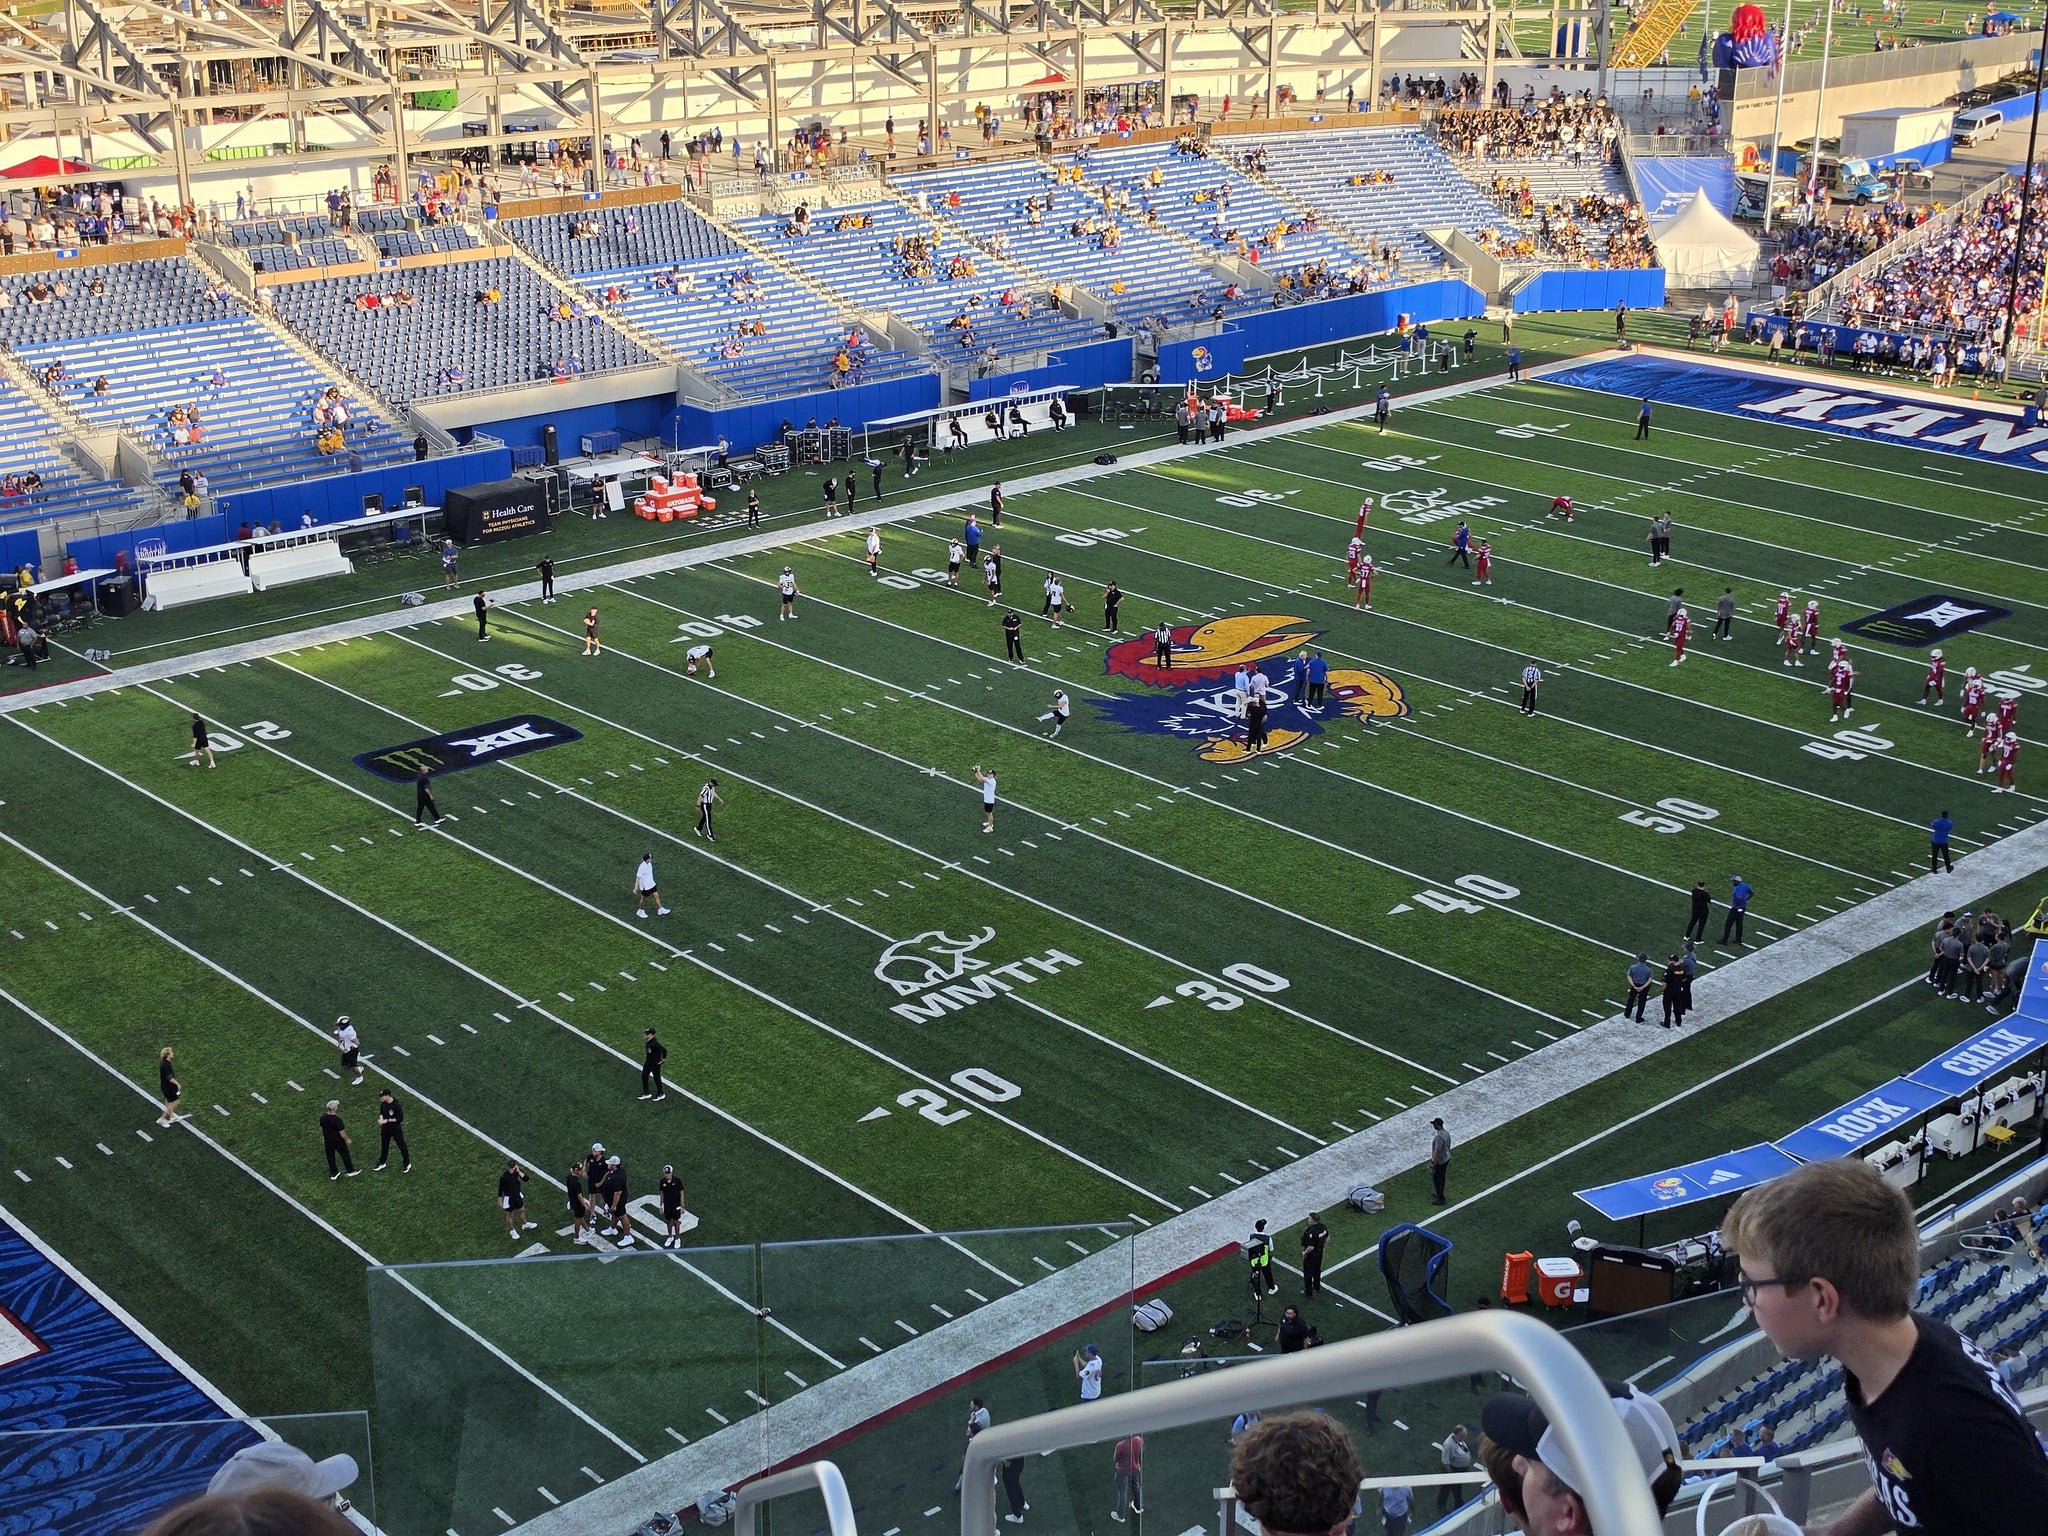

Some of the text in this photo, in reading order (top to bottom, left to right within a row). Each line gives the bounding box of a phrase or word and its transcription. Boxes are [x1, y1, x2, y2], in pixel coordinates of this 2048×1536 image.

[1361, 454, 1427, 471] 20
[492, 504, 535, 519] Health Care
[667, 496, 695, 507] GATORADE
[1215, 489, 1285, 508] 30
[1399, 495, 1509, 525] MMTH
[493, 524, 511, 533] MIZZOU
[511, 519, 536, 529] ATHLETICS
[501, 515, 529, 526] PHYSICIANS
[1054, 527, 1130, 547] 40
[877, 567, 948, 590] 50
[1361, 569, 1370, 578] 37
[678, 613, 764, 637] 40
[451, 663, 543, 691] 30
[202, 720, 292, 752] 20
[1800, 730, 1895, 760] 40
[1617, 797, 1721, 833] 50
[1411, 874, 1521, 914] 40
[889, 948, 1084, 1024] MMTH
[1175, 962, 1290, 1011] 30
[1941, 1028, 2037, 1077] CHALK
[896, 1067, 1022, 1127] 20
[1818, 1096, 1911, 1143] ROCK
[1554, 1281, 1571, 1299] G
